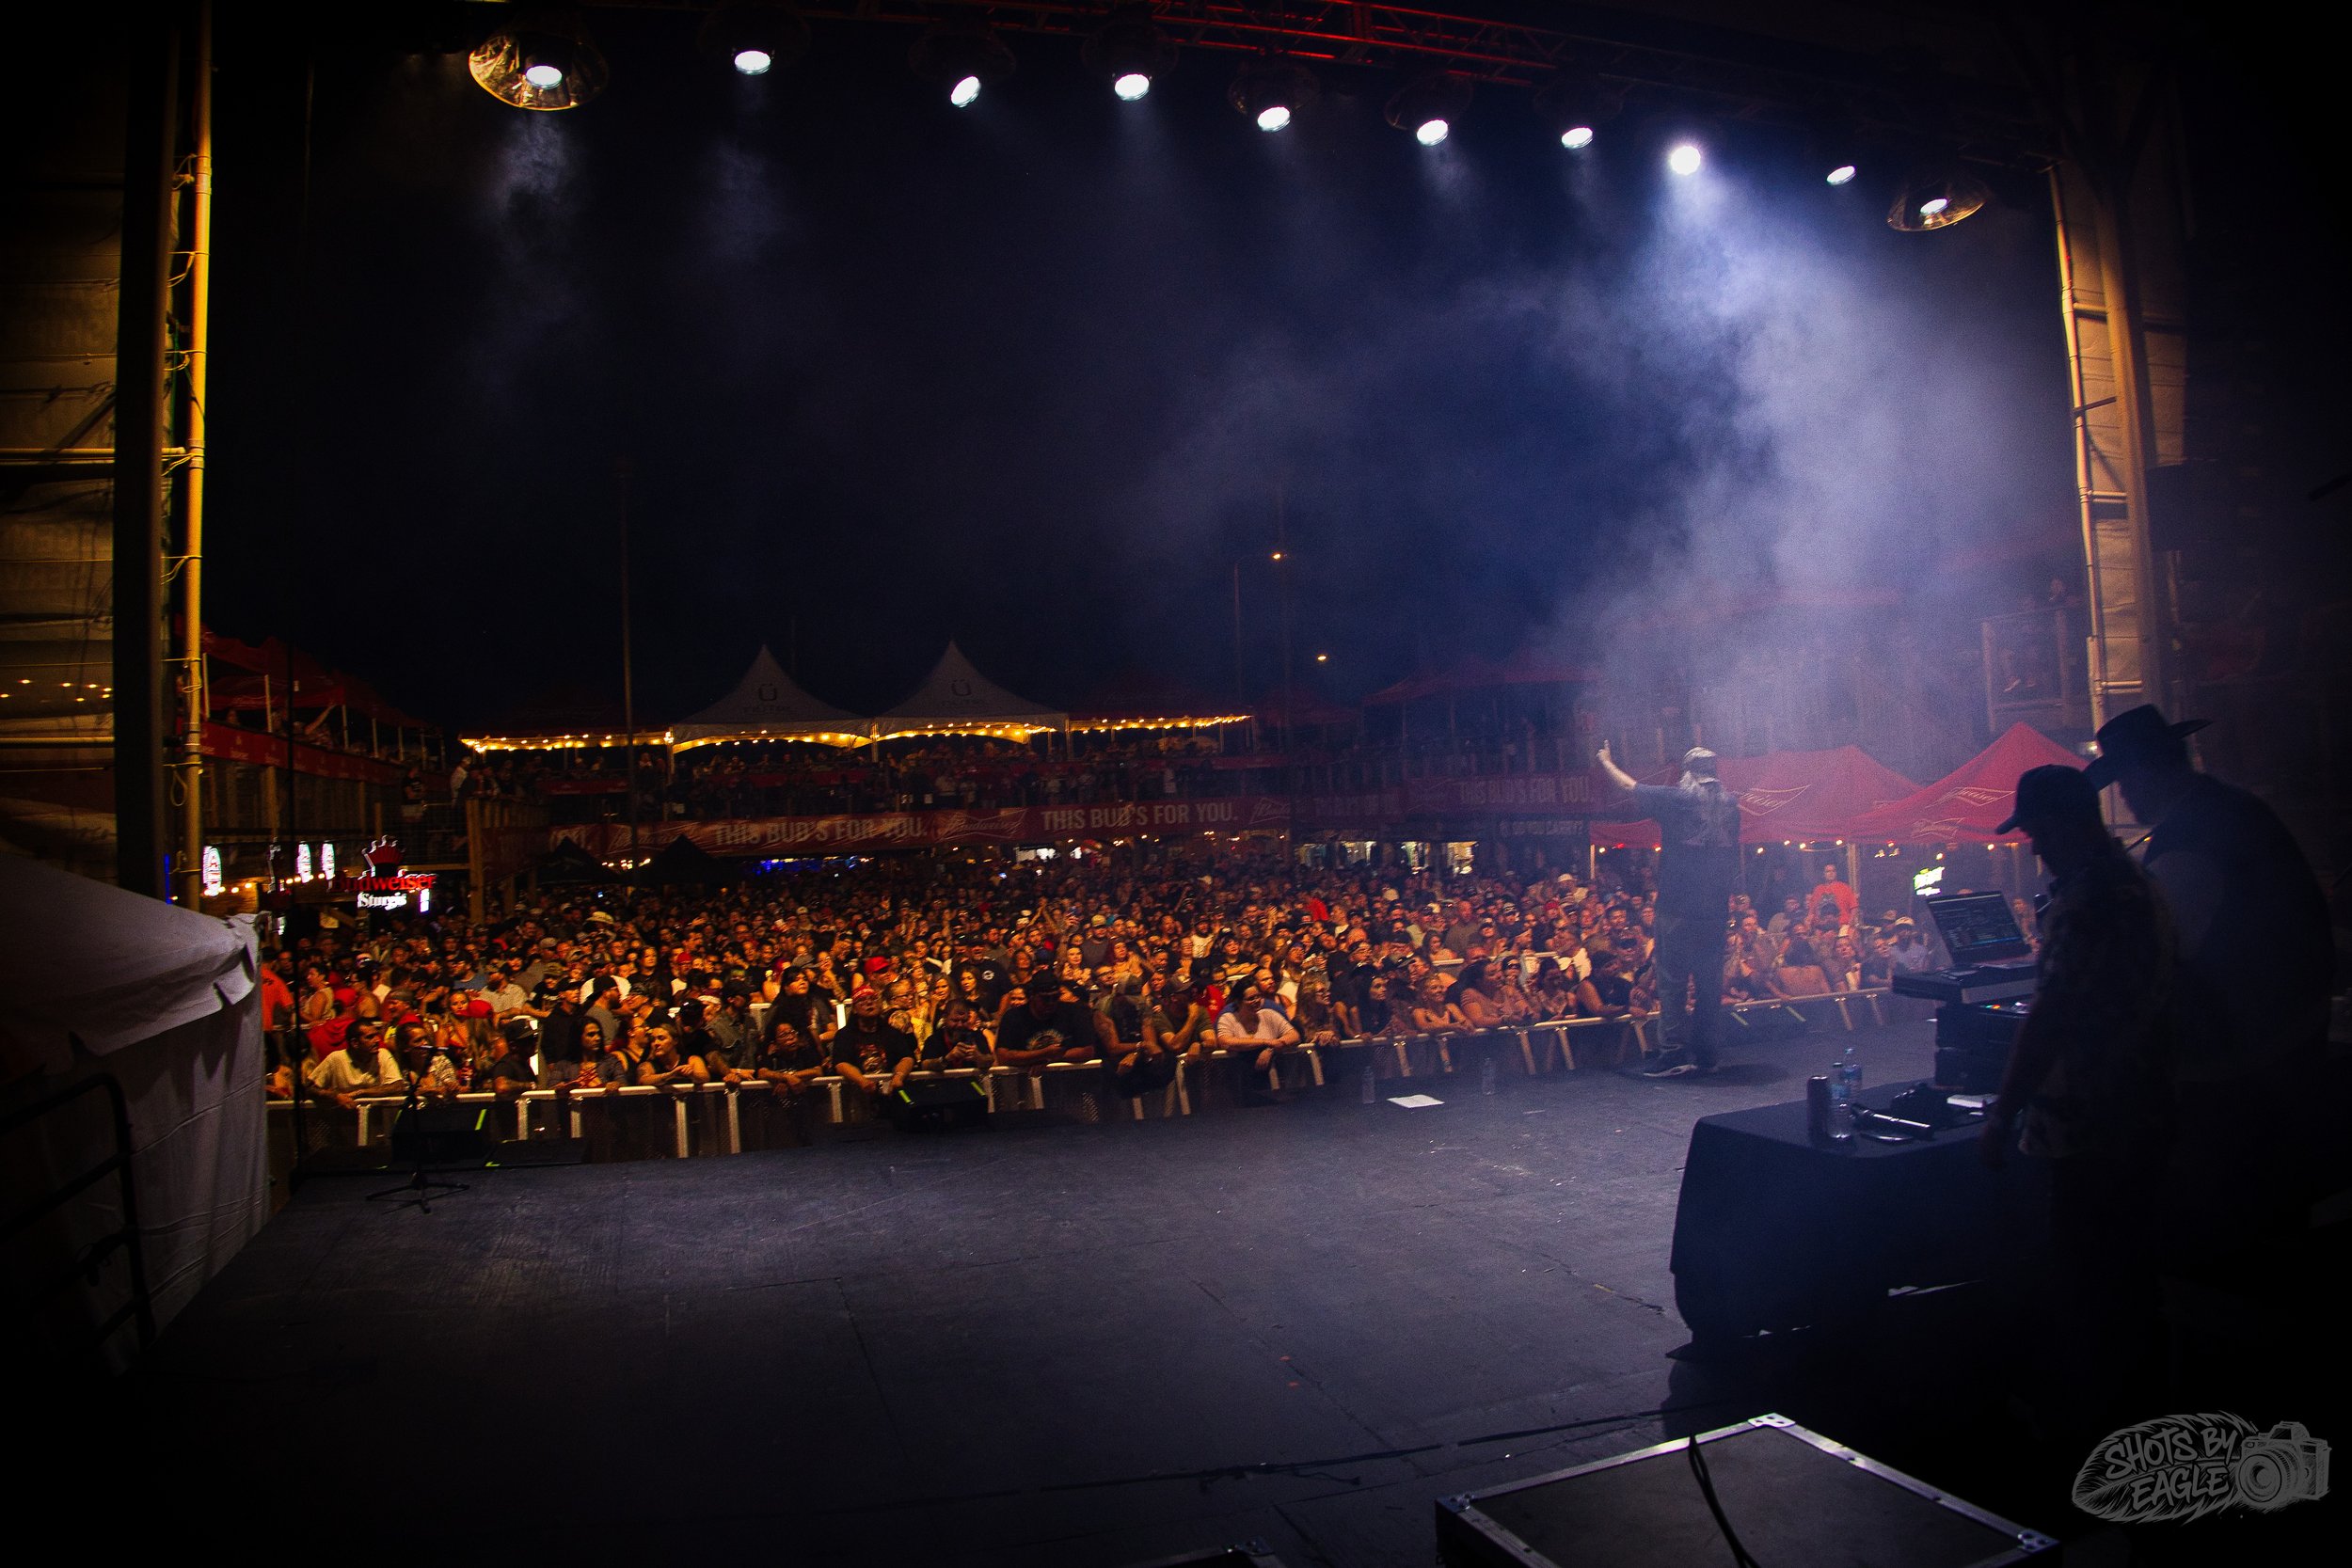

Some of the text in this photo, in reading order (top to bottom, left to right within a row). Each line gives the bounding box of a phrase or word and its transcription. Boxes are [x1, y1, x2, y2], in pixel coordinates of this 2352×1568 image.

[1041, 809, 1086, 831] THIS
[1089, 805, 1149, 828] BUD'S
[1152, 804, 1190, 825] FOR
[1196, 802, 1239, 823] YOU.
[714, 824, 761, 846] THIS
[766, 820, 829, 843] BUD'S
[834, 818, 874, 840] FOR
[882, 816, 928, 838] YOU.
[333, 870, 437, 892] Budweiser
[358, 892, 406, 911] Sturgis
